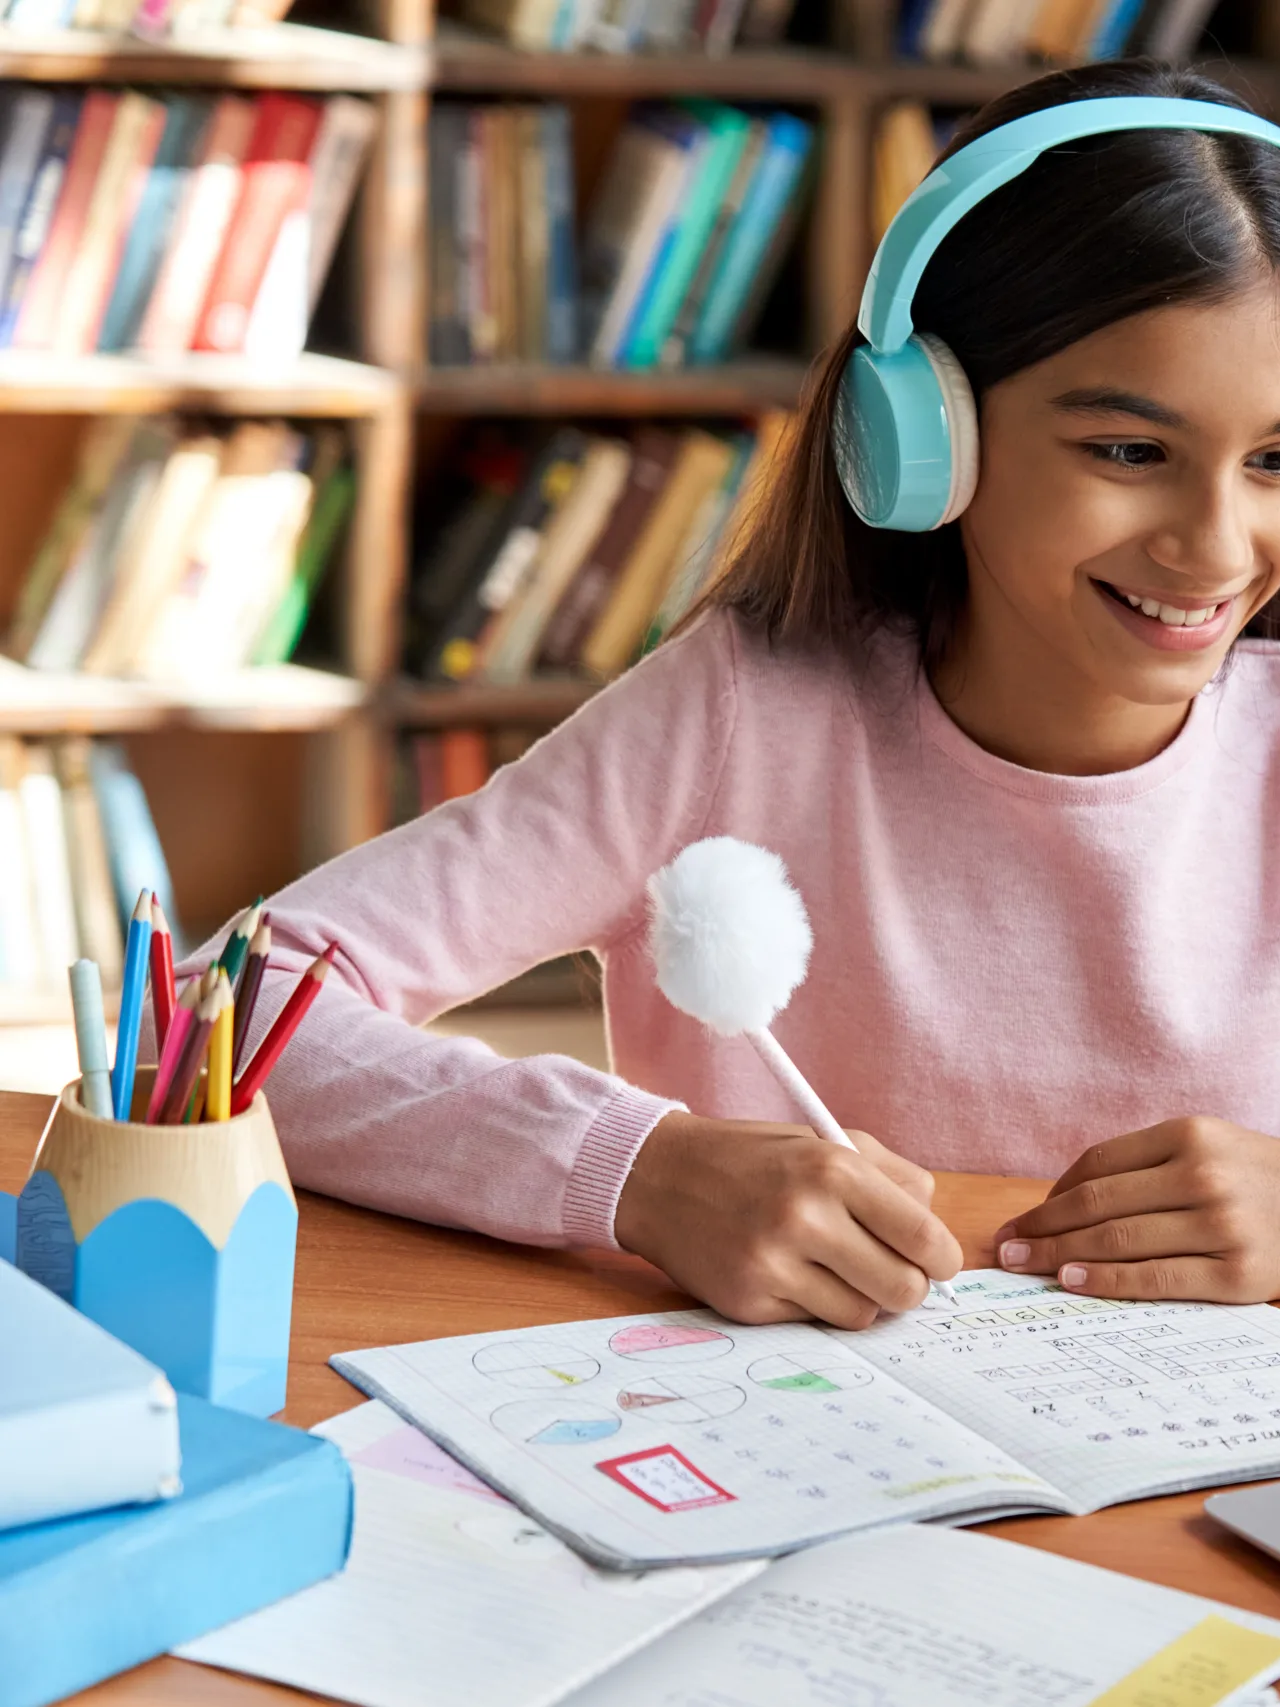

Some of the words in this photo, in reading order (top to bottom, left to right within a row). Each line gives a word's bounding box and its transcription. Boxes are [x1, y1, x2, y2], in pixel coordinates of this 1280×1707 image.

[1049, 1306, 1065, 1315] 5
[1015, 1311, 1036, 1320] 9
[975, 1316, 997, 1325] 4
